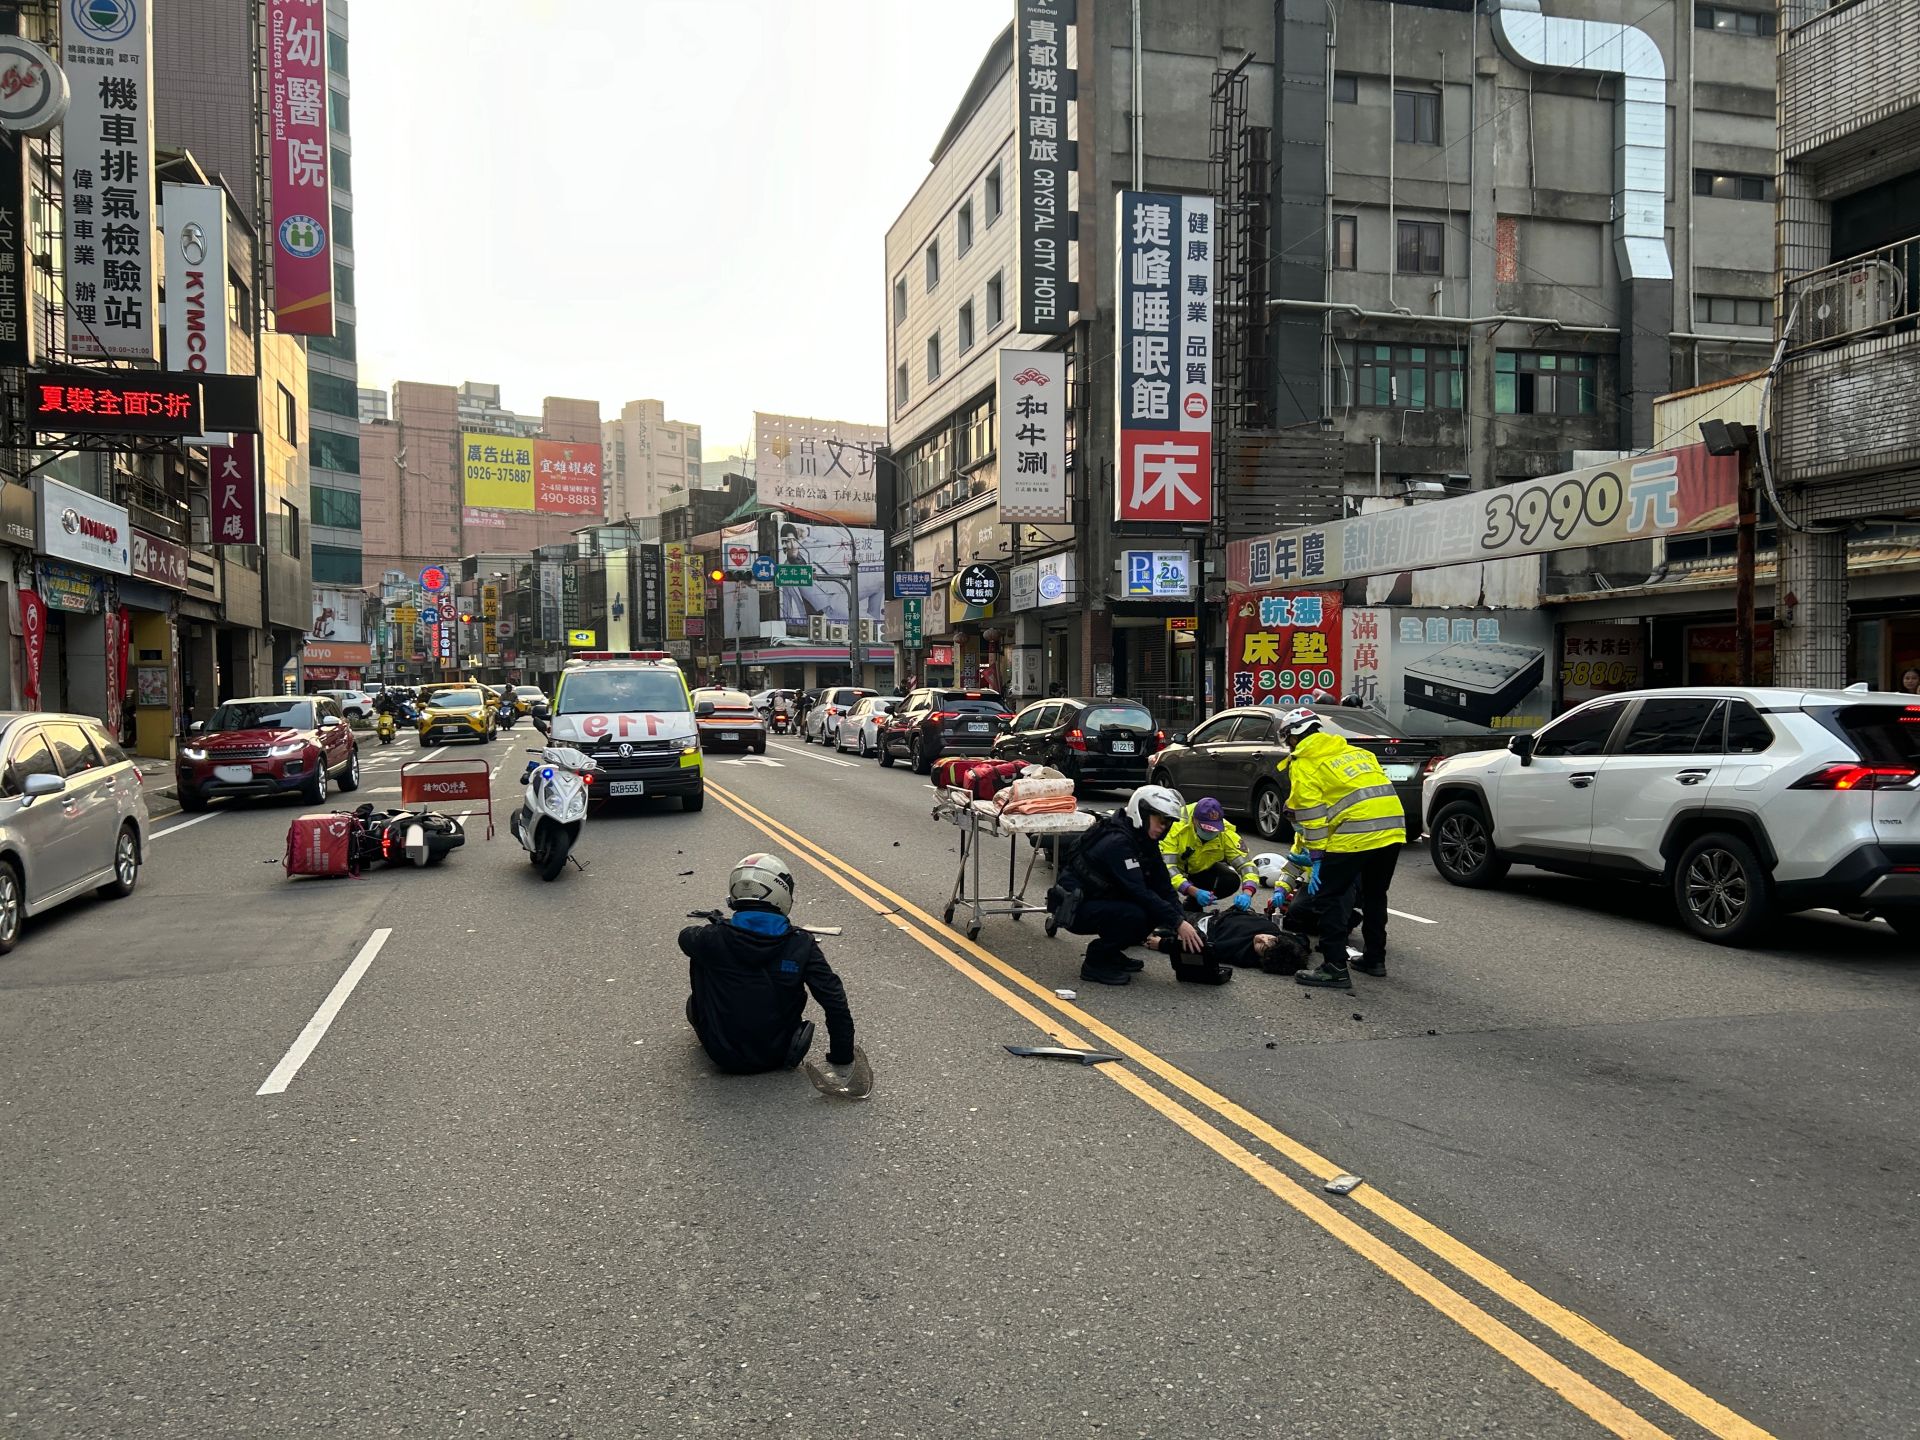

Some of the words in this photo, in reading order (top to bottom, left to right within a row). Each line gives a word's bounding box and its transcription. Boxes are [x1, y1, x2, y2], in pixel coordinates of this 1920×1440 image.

[273, 10, 285, 79] Children's
[273, 83, 286, 141] Hospital
[286, 0, 324, 187] 幼醫院
[1027, 20, 1058, 163] 貴都城市商旅
[72, 168, 96, 266] 偉譽車業
[99, 75, 143, 330] 機車排氣檢驗站
[1033, 168, 1055, 232] CRYSTAL
[1033, 238, 1056, 272] CITY
[1187, 212, 1209, 262] 健康
[75, 281, 97, 325] 辦理
[184, 270, 208, 373] KYMCO
[1034, 276, 1056, 324] HOTEL
[1131, 203, 1171, 420] 捷峰睡眠館
[1187, 274, 1208, 323] 專業
[1186, 336, 1208, 385] 品質
[38, 385, 192, 418] 夏裝全面5折
[467, 444, 531, 466] 廣告出租
[1015, 394, 1048, 475] 和牛涮
[221, 454, 244, 540] 大尺碼
[467, 465, 532, 483] 0926-375887
[1129, 441, 1202, 511] 床
[540, 493, 597, 506] 490-8883
[1249, 530, 1326, 586] 週年慶
[1343, 500, 1477, 572] 熱銷床墊
[1481, 455, 1679, 550] 3990元
[780, 568, 808, 576] 元化路
[895, 573, 930, 584] 健行科技大學
[1161, 566, 1179, 579] 20
[1259, 596, 1323, 627] 抗漲
[1399, 617, 1500, 644] 全館床墊
[304, 646, 332, 659] kuyo
[1242, 631, 1328, 665] 床墊
[1258, 669, 1335, 690] 3990
[610, 783, 642, 794] BXB-5531
